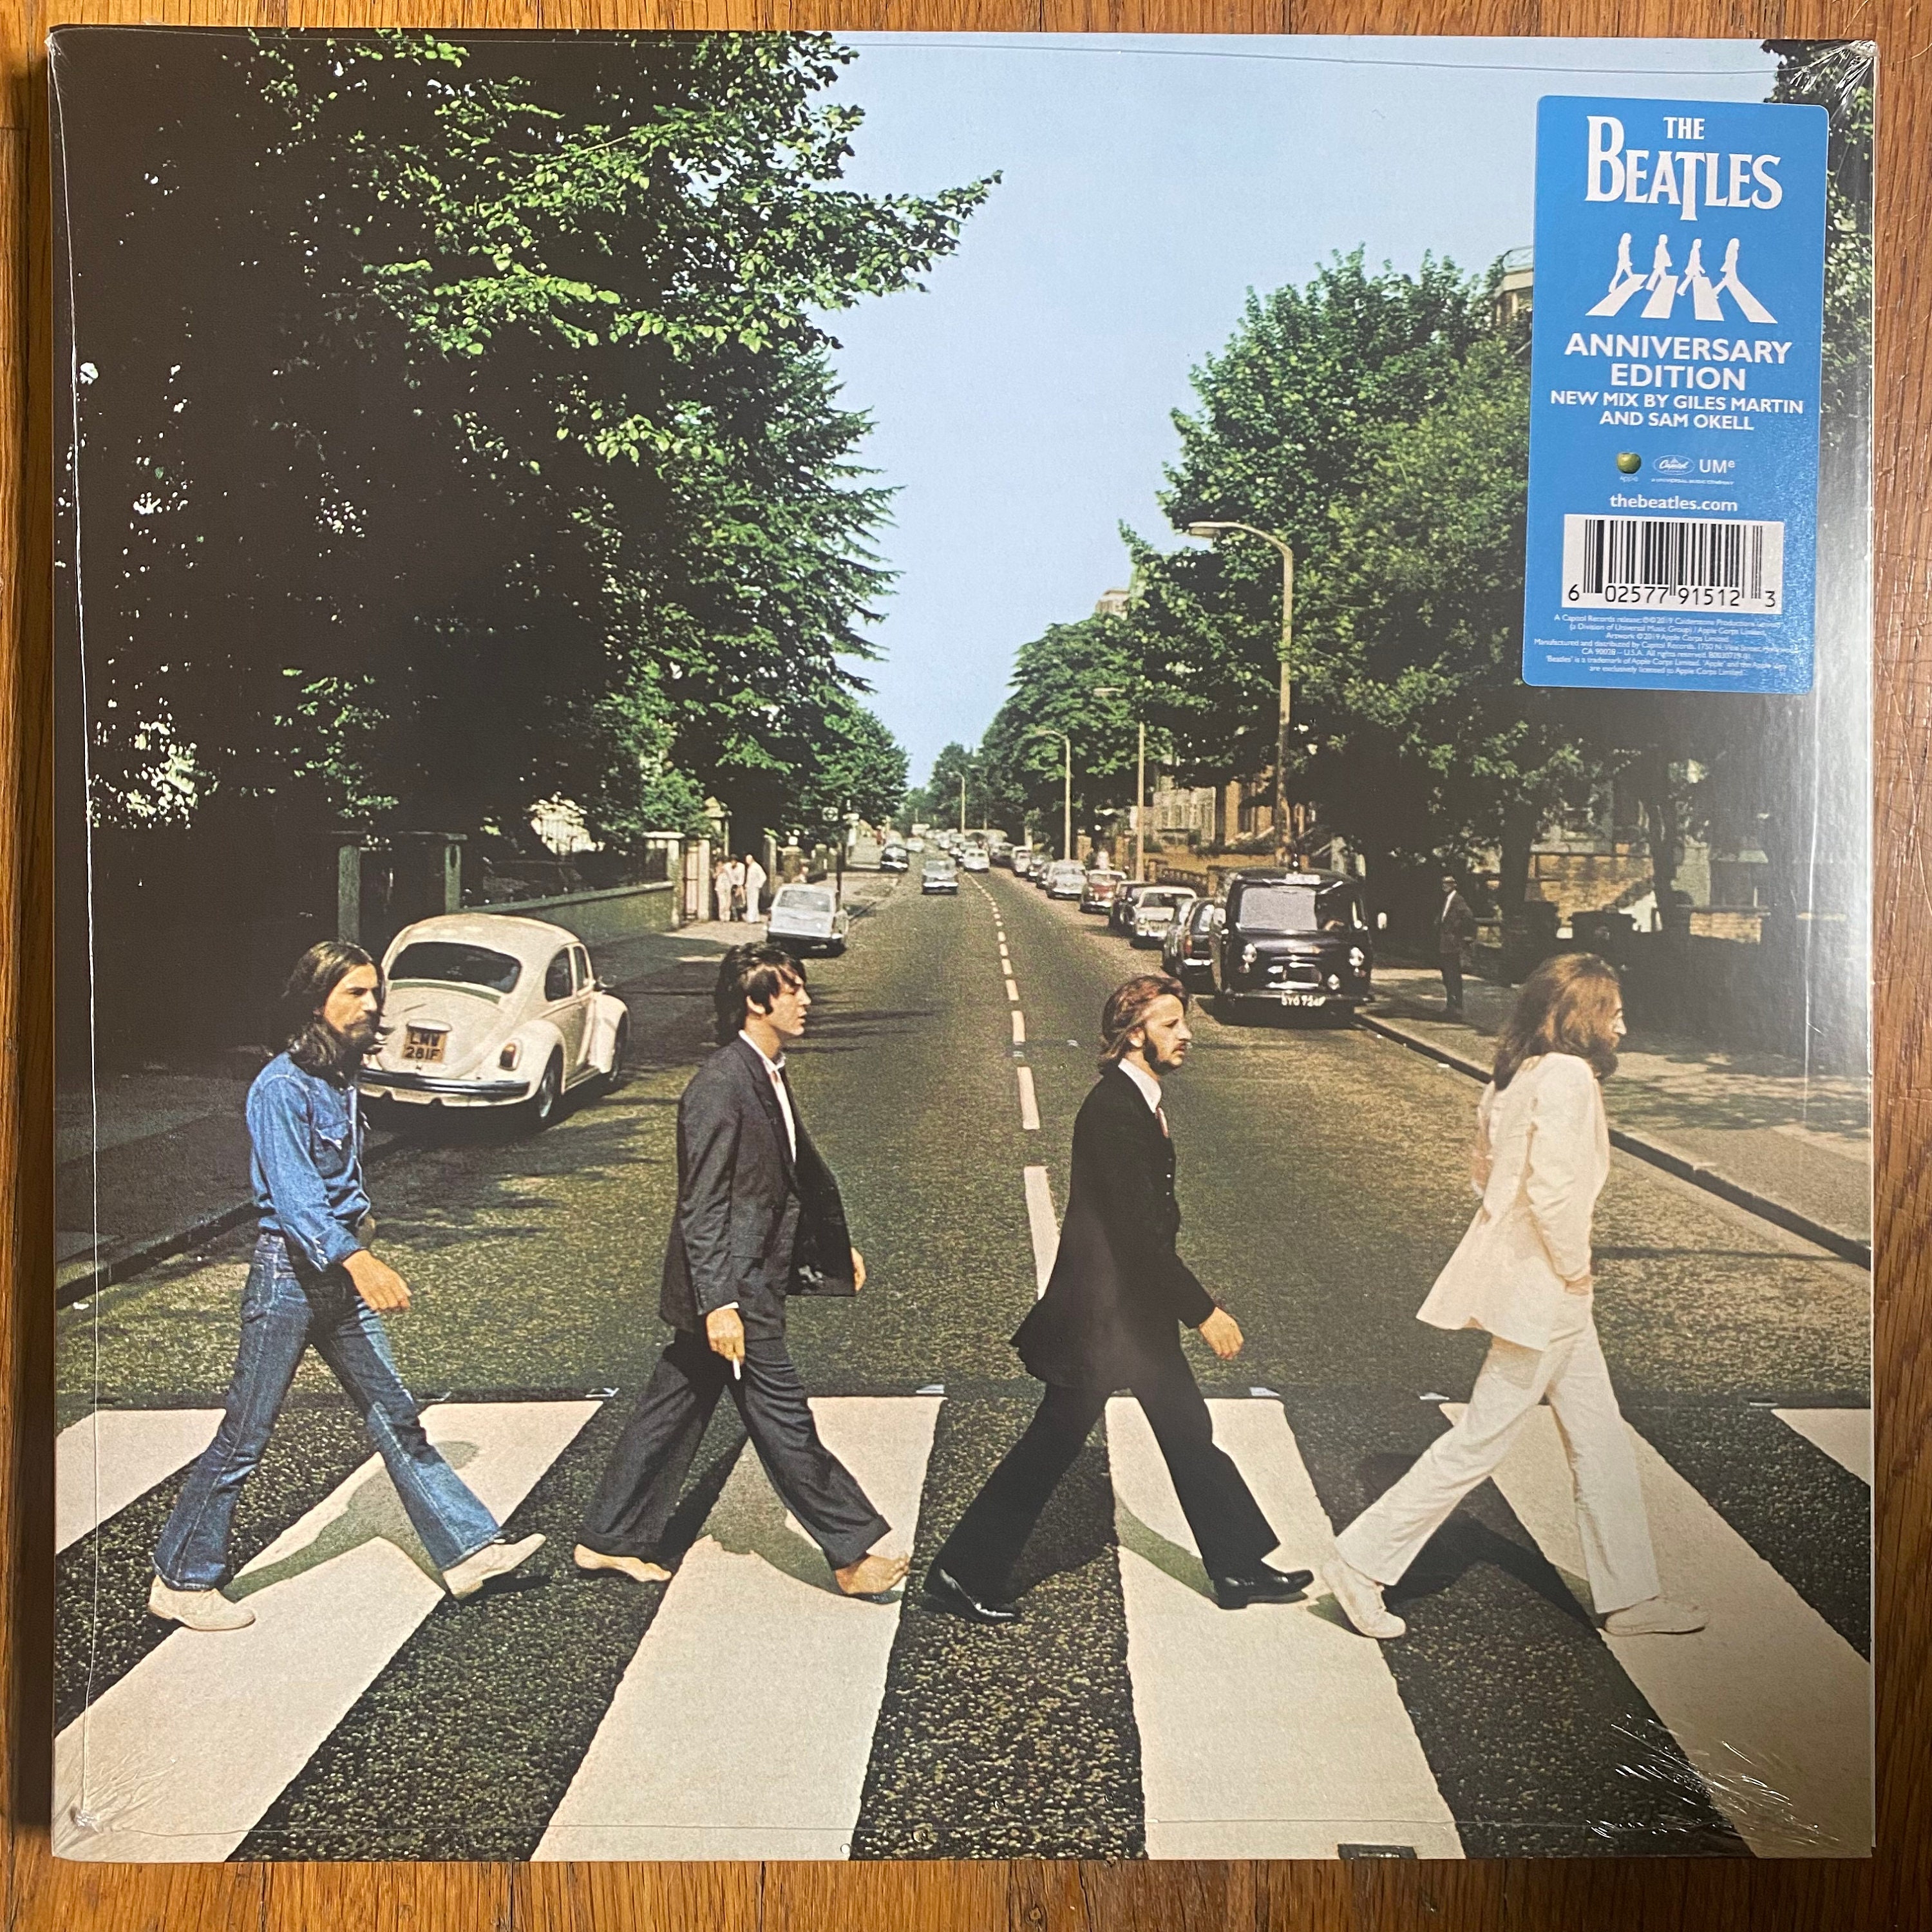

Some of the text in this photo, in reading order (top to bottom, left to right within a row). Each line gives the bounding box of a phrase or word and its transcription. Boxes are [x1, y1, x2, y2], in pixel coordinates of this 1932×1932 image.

[1663, 117, 1705, 140] THE
[1585, 115, 1783, 221] BEATLES
[1564, 332, 1792, 364] ANNIVERSARY
[1611, 363, 1746, 391] EDITION
[1551, 390, 1804, 414] NEW MIX BY GILES MARTIN
[1599, 410, 1755, 431] AND SAM OKELL
[1609, 493, 1738, 512] thebeatles.com
[1568, 584, 1776, 607] 6 02577 91512 3
